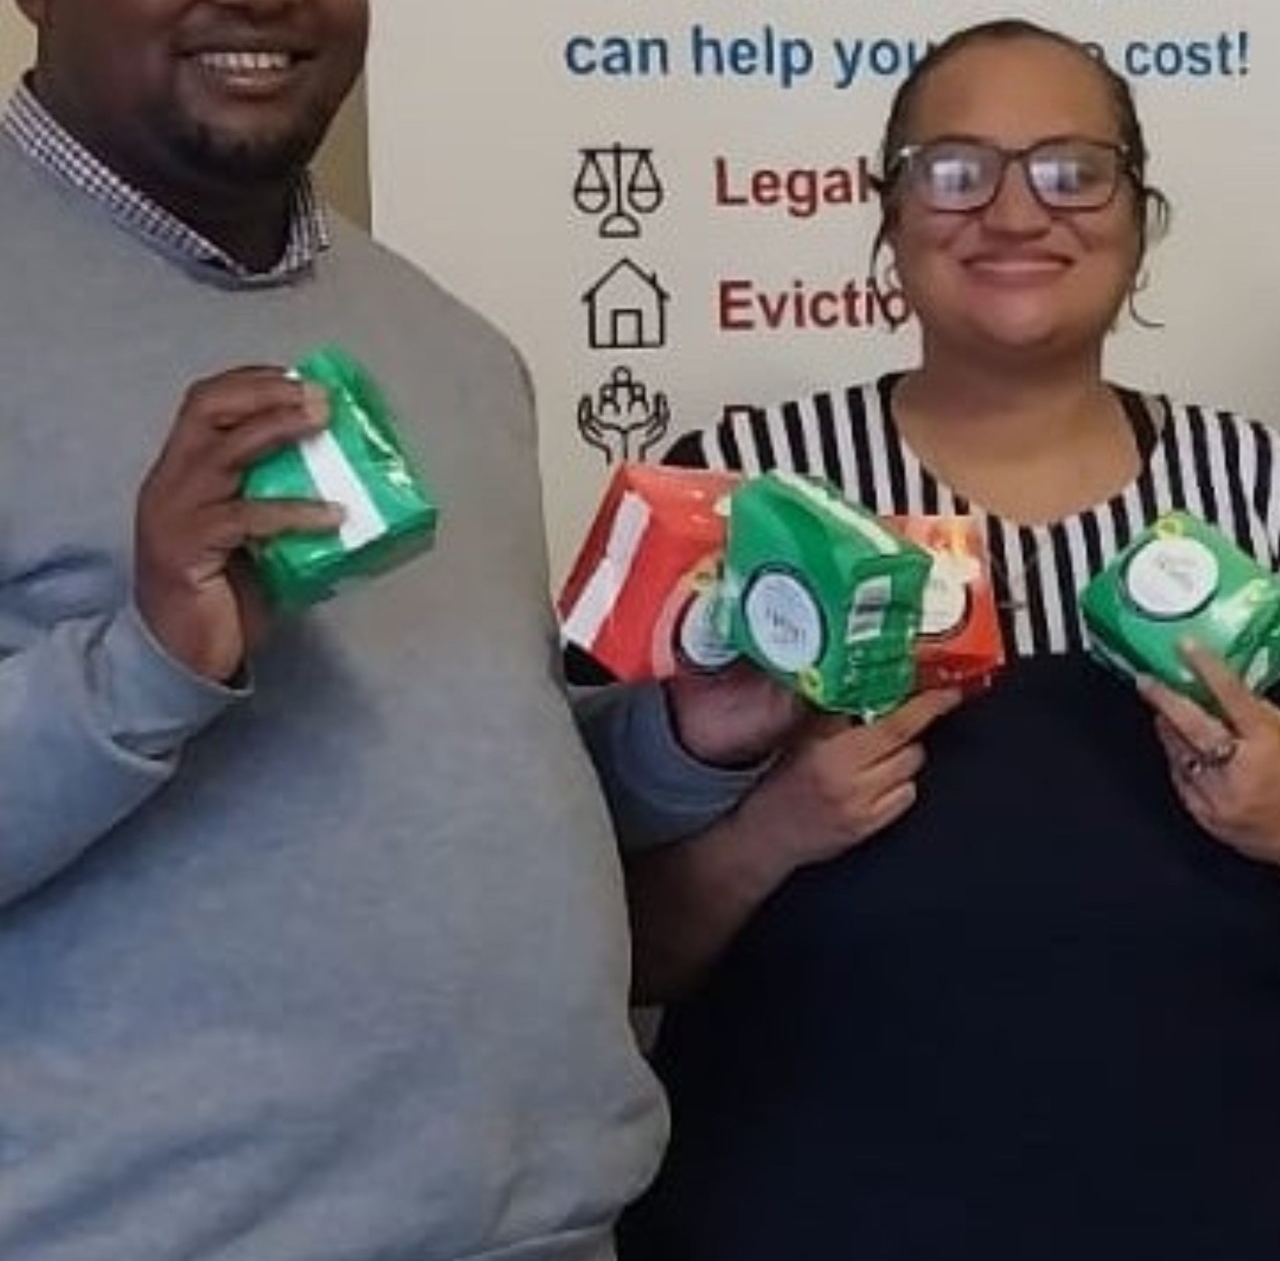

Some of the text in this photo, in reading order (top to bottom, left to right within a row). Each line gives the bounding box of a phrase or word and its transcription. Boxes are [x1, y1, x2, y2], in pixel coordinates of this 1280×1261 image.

[564, 36, 669, 76] can
[691, 24, 814, 89] help
[1124, 30, 1250, 77] cost!
[714, 155, 869, 219] Legal
[719, 279, 912, 331] Evictio
